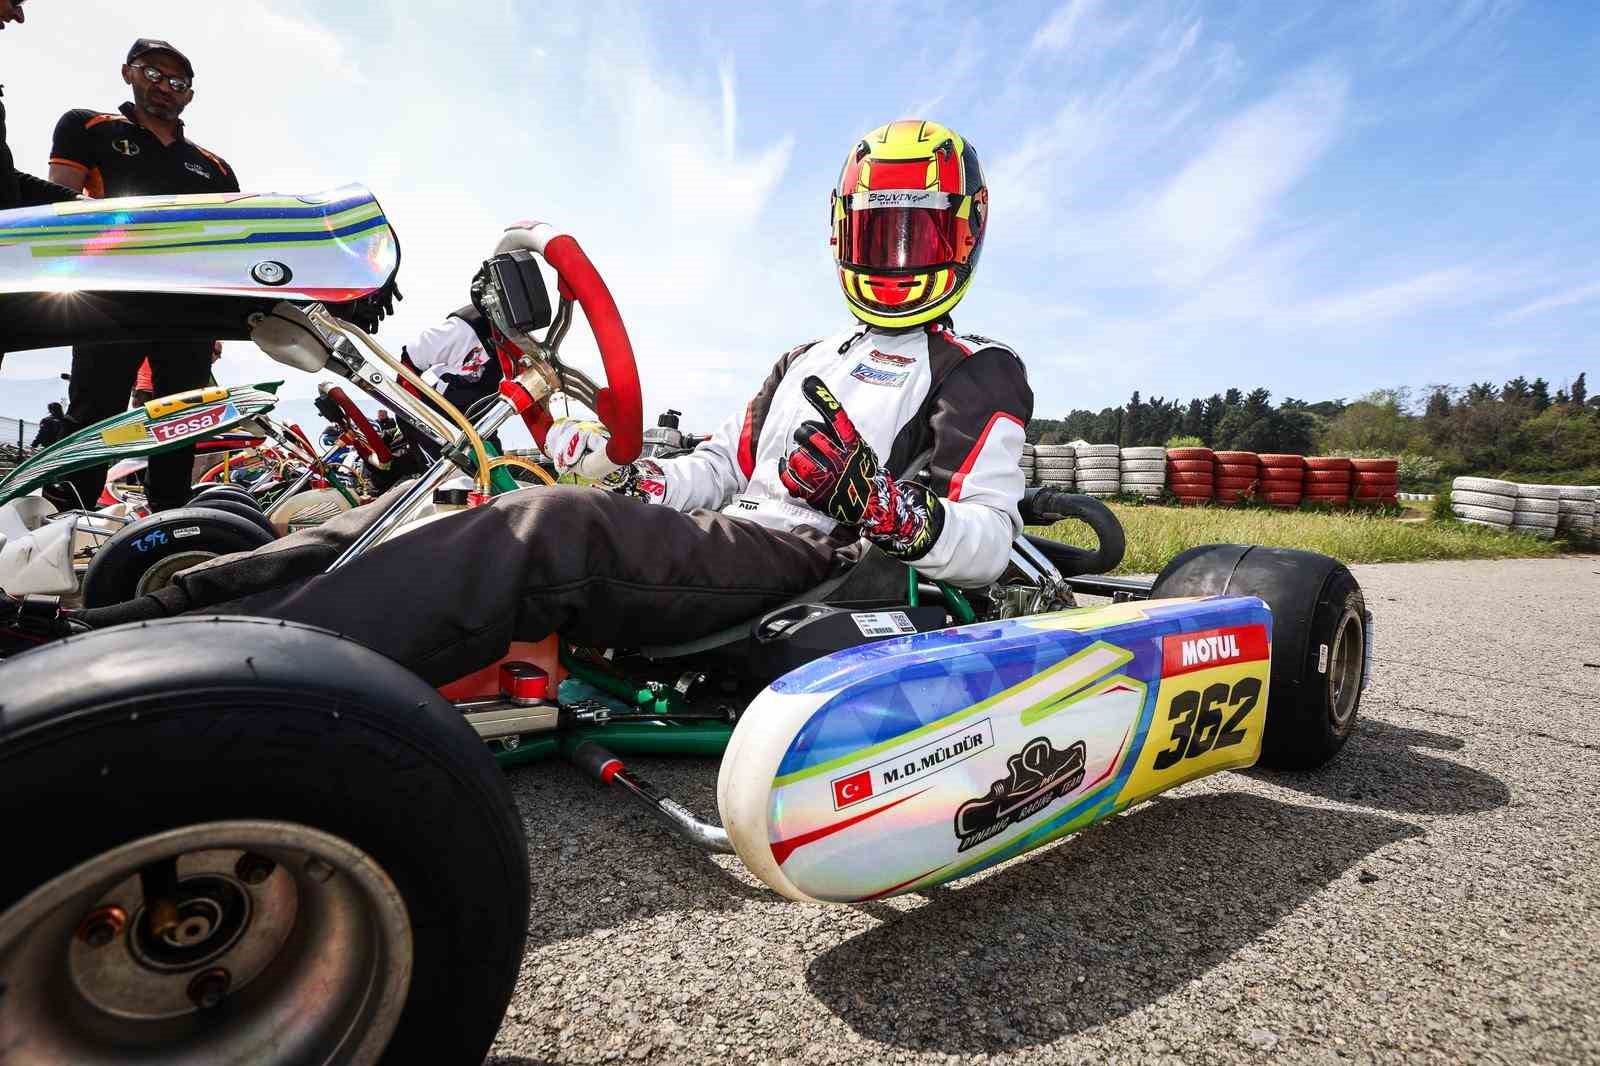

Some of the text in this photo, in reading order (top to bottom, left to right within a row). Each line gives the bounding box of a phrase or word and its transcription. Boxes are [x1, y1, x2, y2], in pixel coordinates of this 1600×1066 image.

[159, 414, 214, 439] tesa
[1181, 634, 1240, 667] MOTUL
[1152, 677, 1262, 771] 362
[882, 733, 984, 785] M.O.MÜLDÜR
[961, 772, 1084, 850] DYNAMIC RACING TEAM
